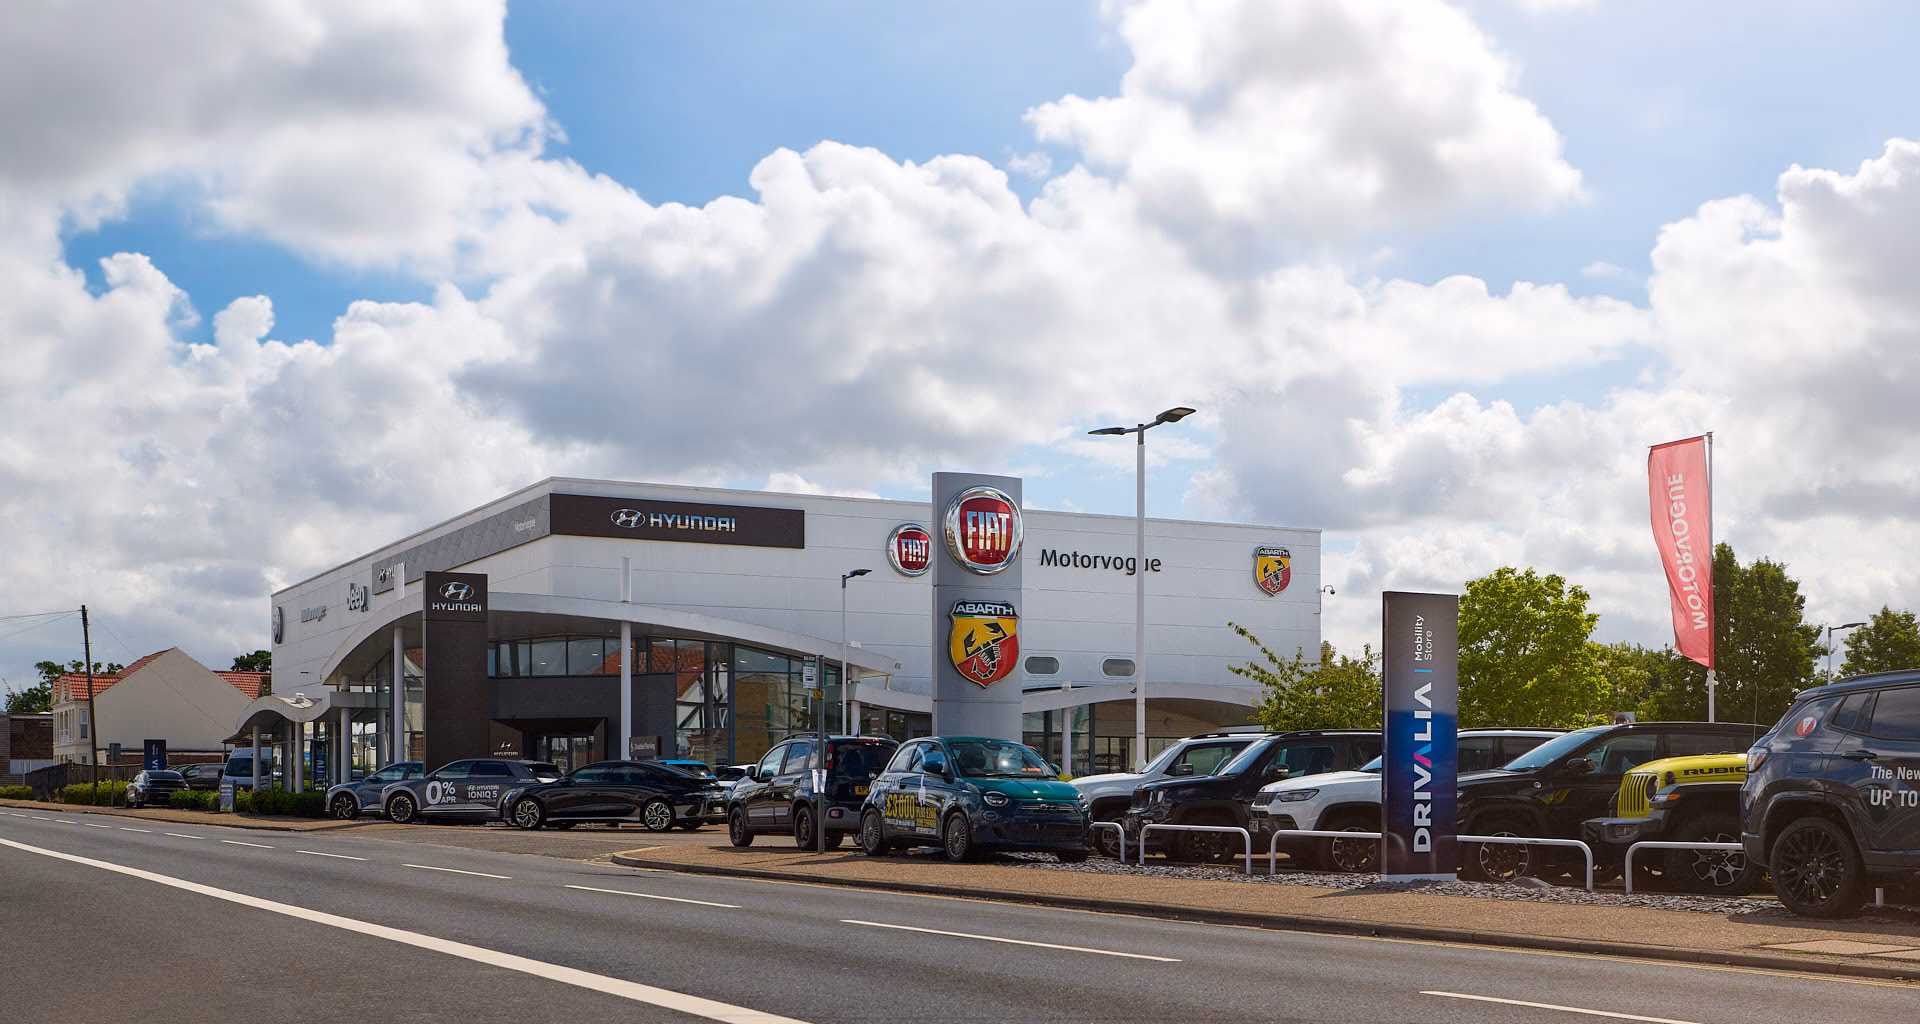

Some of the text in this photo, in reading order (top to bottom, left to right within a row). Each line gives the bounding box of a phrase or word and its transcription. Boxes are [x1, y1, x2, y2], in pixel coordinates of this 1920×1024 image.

[649, 512, 736, 532] HYUNDAI
[966, 511, 1010, 552] FIAT
[901, 538, 928, 563] FIAT
[346, 583, 369, 613] Jeep
[432, 602, 482, 612] HYUNDAI
[955, 603, 1013, 615] ABARTH
[1414, 615, 1425, 661] Mobility
[1424, 630, 1433, 661] Store
[1413, 681, 1433, 852] DRIVALIA
[1871, 766, 1893, 780] The
[440, 795, 457, 804] APR
[468, 790, 498, 799] IONIQ 5
[1870, 789, 1918, 807] UP TO
